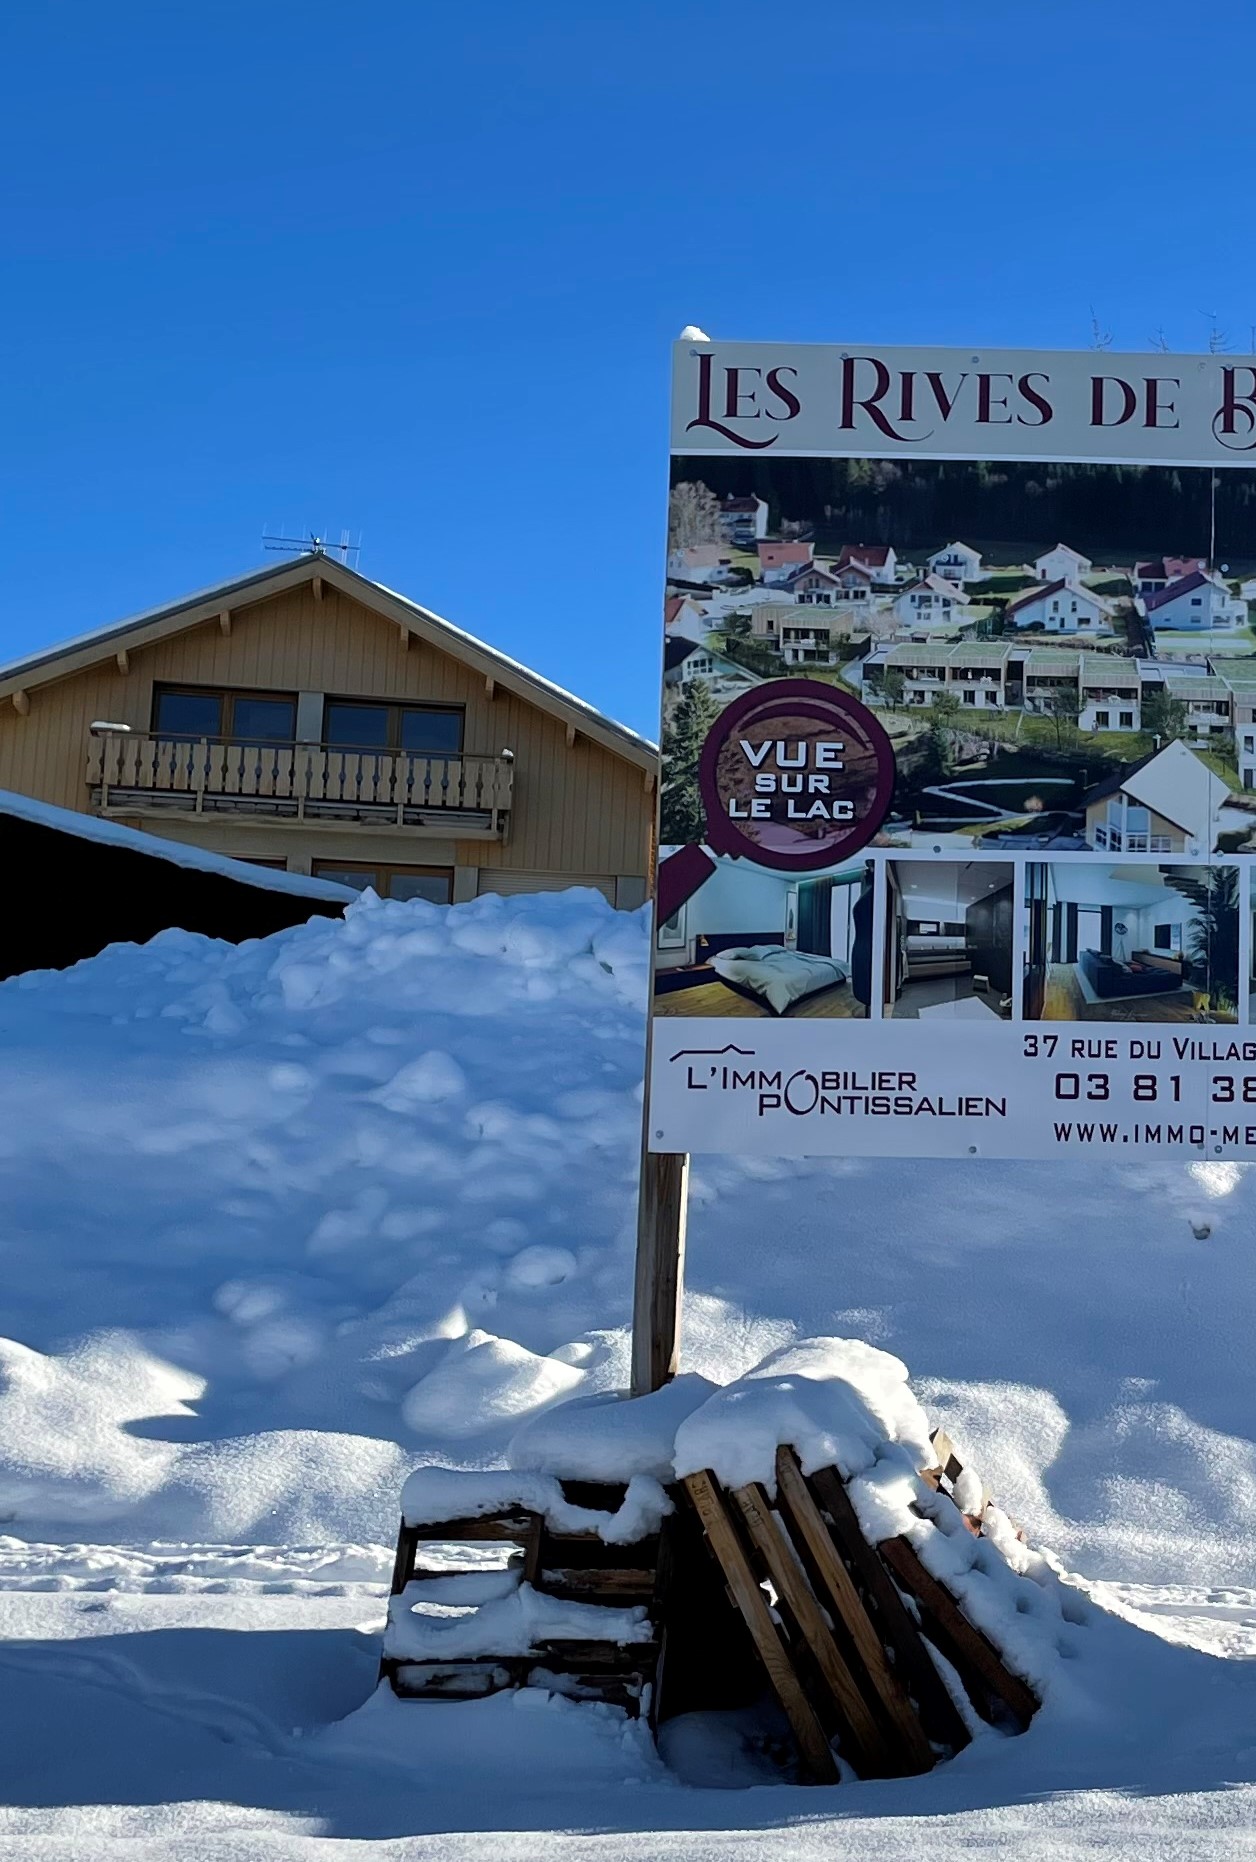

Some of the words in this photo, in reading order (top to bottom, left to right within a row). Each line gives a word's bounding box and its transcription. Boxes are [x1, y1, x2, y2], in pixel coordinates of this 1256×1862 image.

[685, 353, 800, 449] LES
[838, 356, 1054, 442] RIVES
[1090, 376, 1181, 428] DE
[740, 740, 844, 768] VUE
[755, 773, 830, 793] SUR
[729, 799, 771, 817] LE
[788, 800, 854, 819] LAC
[1023, 1035, 1059, 1058] 37
[1071, 1039, 1118, 1059] RUE
[1130, 1040, 1161, 1060] DU
[1055, 1073, 1109, 1101] 03
[1133, 1075, 1181, 1102] 81
